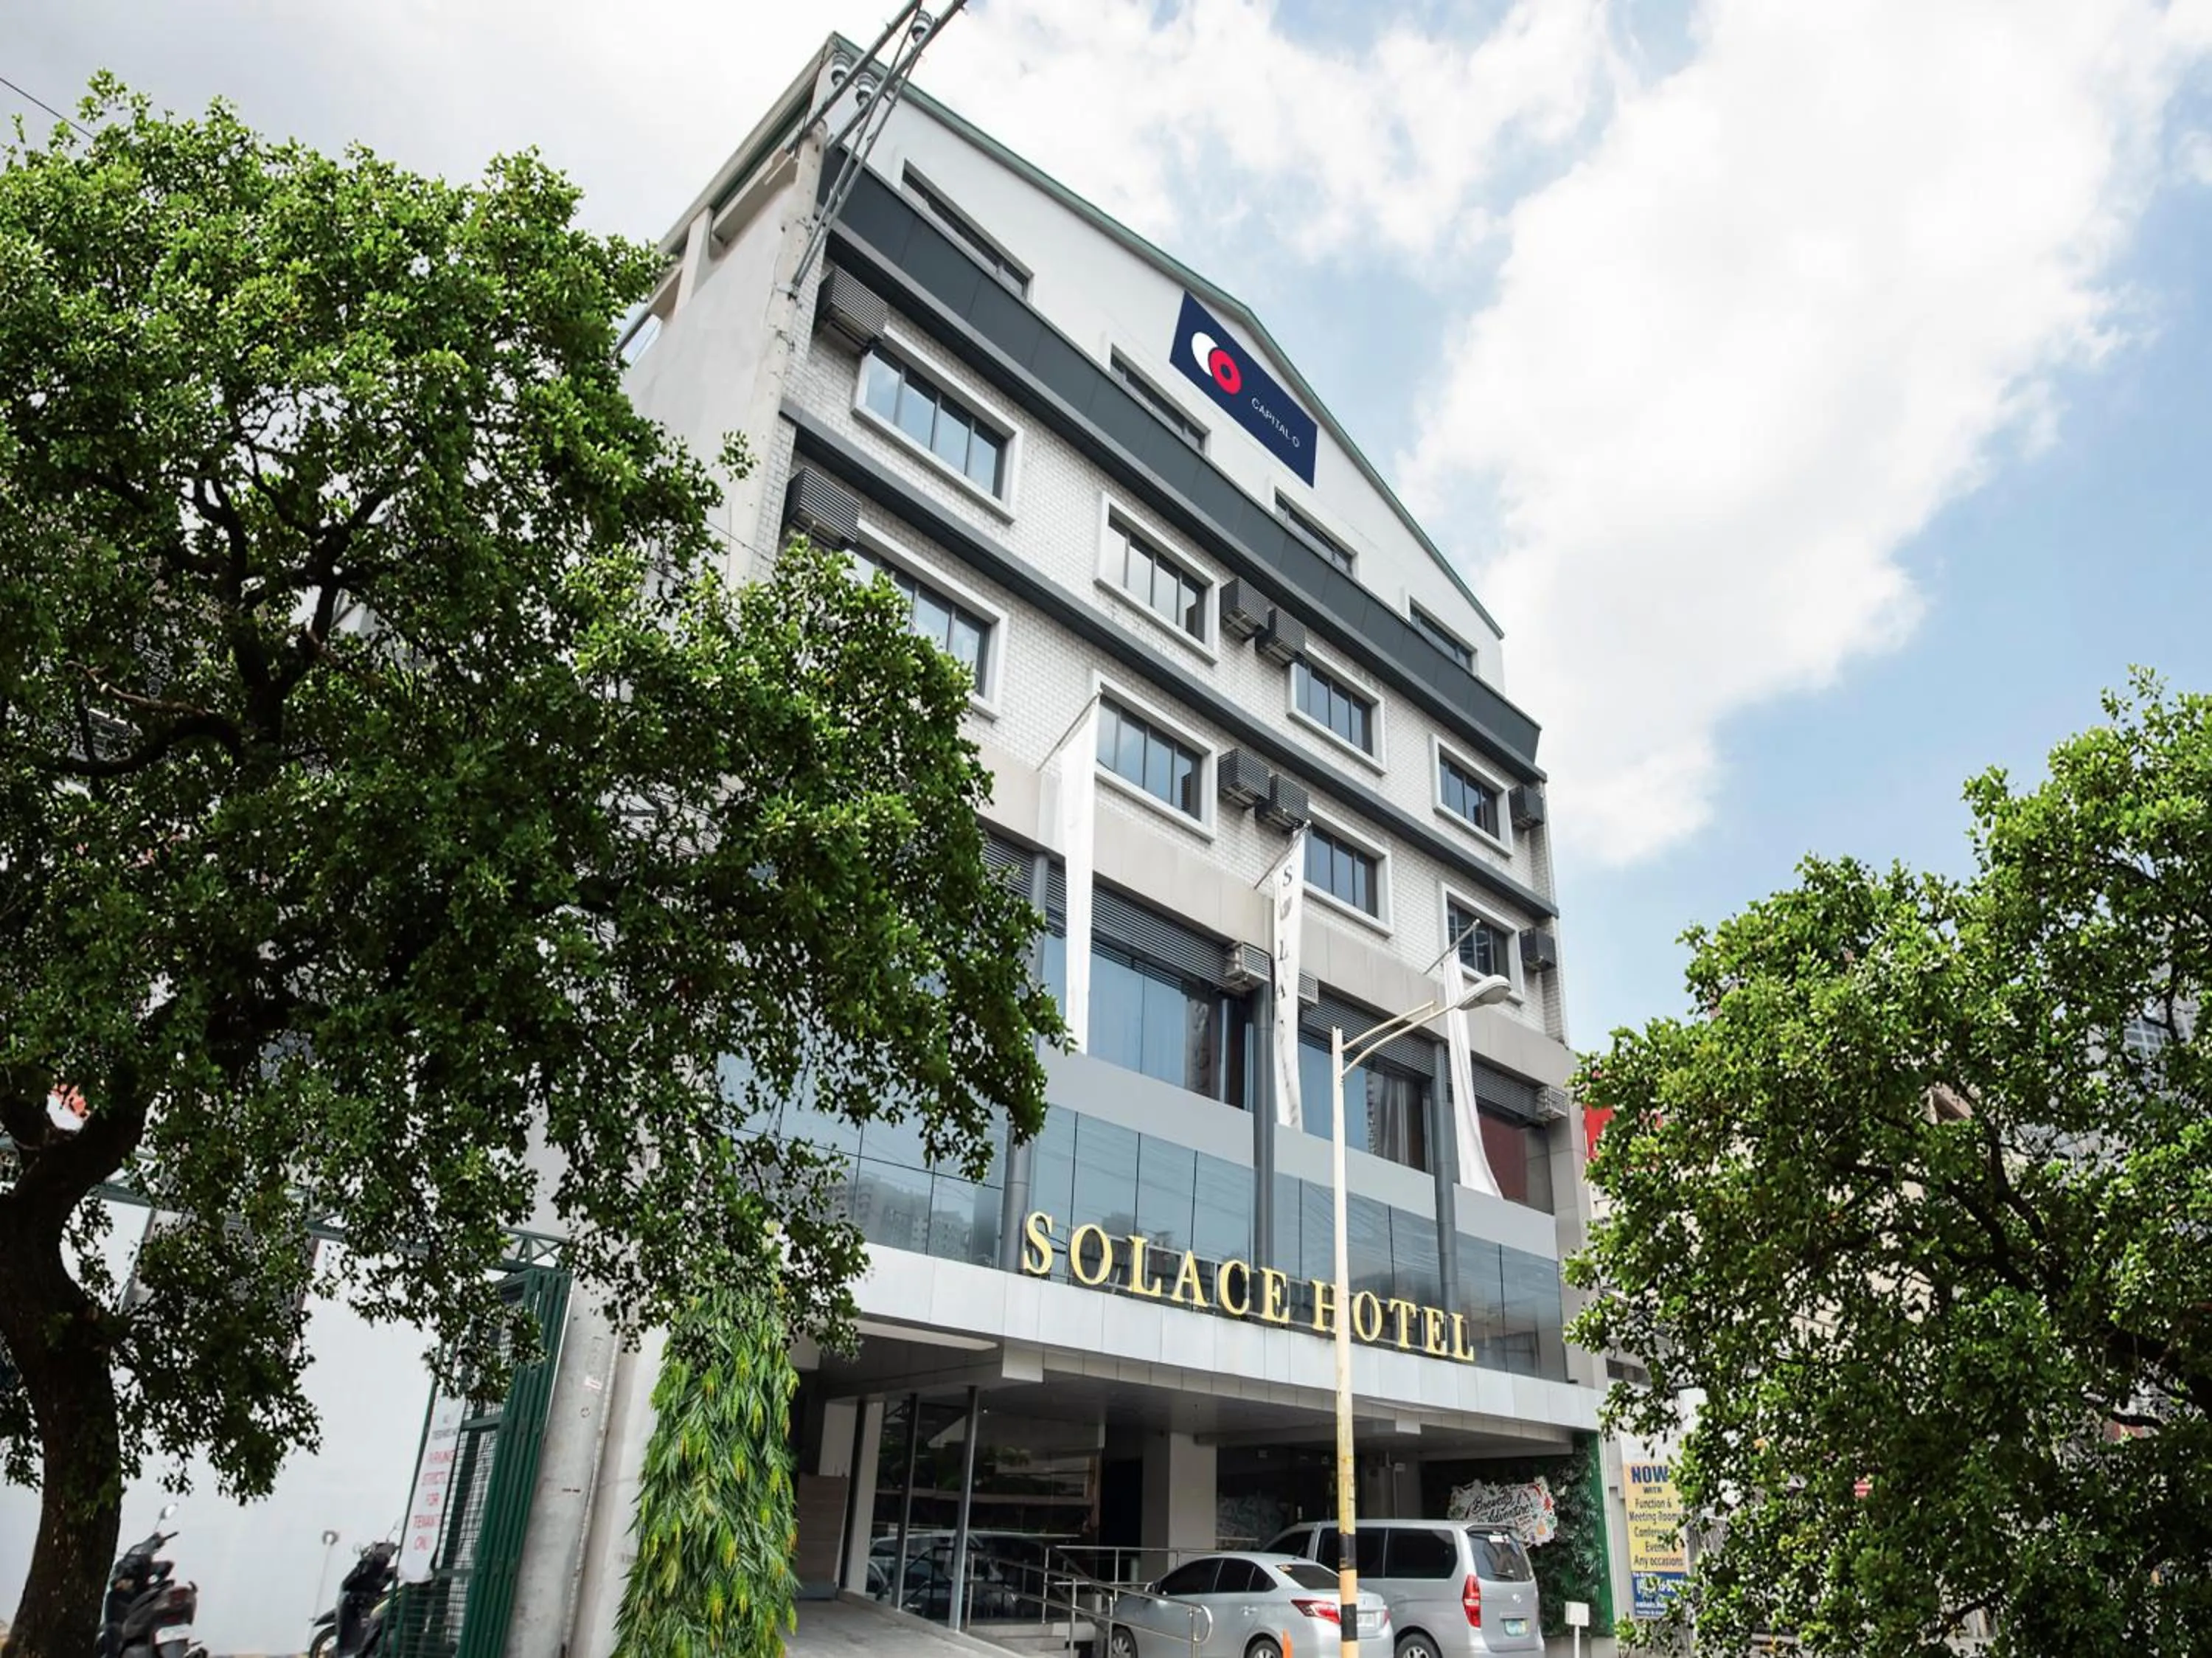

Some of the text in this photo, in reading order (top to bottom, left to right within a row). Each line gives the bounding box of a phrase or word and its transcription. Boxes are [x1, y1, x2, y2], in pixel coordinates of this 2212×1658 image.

[1251, 397, 1301, 448] CAPITAL O
[1022, 1211, 1475, 1362] SOLACE HOTEL
[1630, 1465, 1669, 1484] NOW
[1635, 1499, 1665, 1509] Function
[1628, 1511, 1657, 1525] Meeting
[1634, 1555, 1649, 1569] Any
